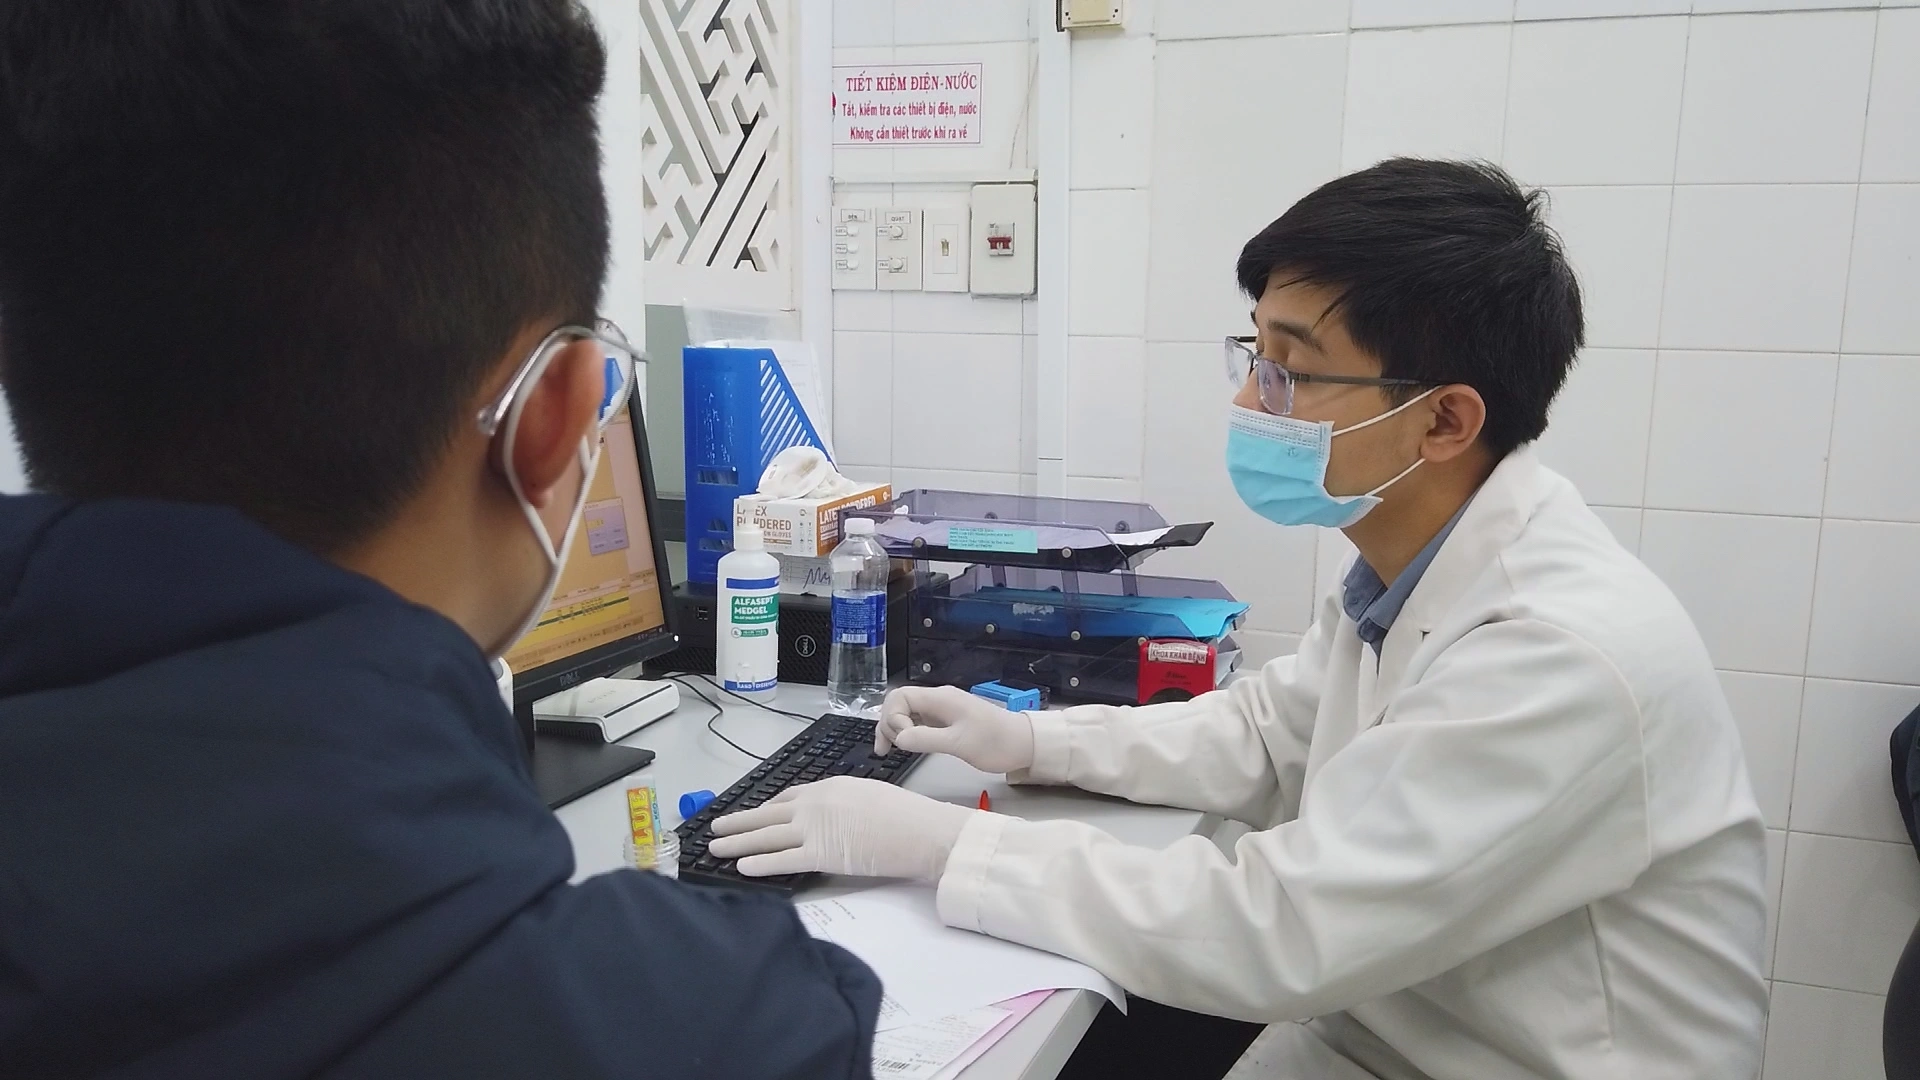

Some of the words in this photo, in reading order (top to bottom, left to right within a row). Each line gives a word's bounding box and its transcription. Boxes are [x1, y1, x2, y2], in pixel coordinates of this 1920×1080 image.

[846, 70, 873, 92] TIẾT
[876, 73, 907, 94] KIỆM
[859, 99, 878, 116] kiểm
[880, 103, 891, 116] tra
[893, 102, 906, 116] các
[908, 100, 926, 116] thiết
[850, 126, 874, 142] Không
[876, 125, 890, 139] cần
[892, 125, 909, 139] thiết
[911, 126, 932, 139] trước
[934, 125, 946, 138] khi
[948, 128, 956, 139] ra
[959, 124, 968, 139] về
[736, 504, 767, 517] LEX
[819, 506, 841, 525] LATE
[736, 516, 792, 531] PDERED
[734, 596, 774, 606] ALFASEPT
[734, 606, 768, 615] MEDGEL
